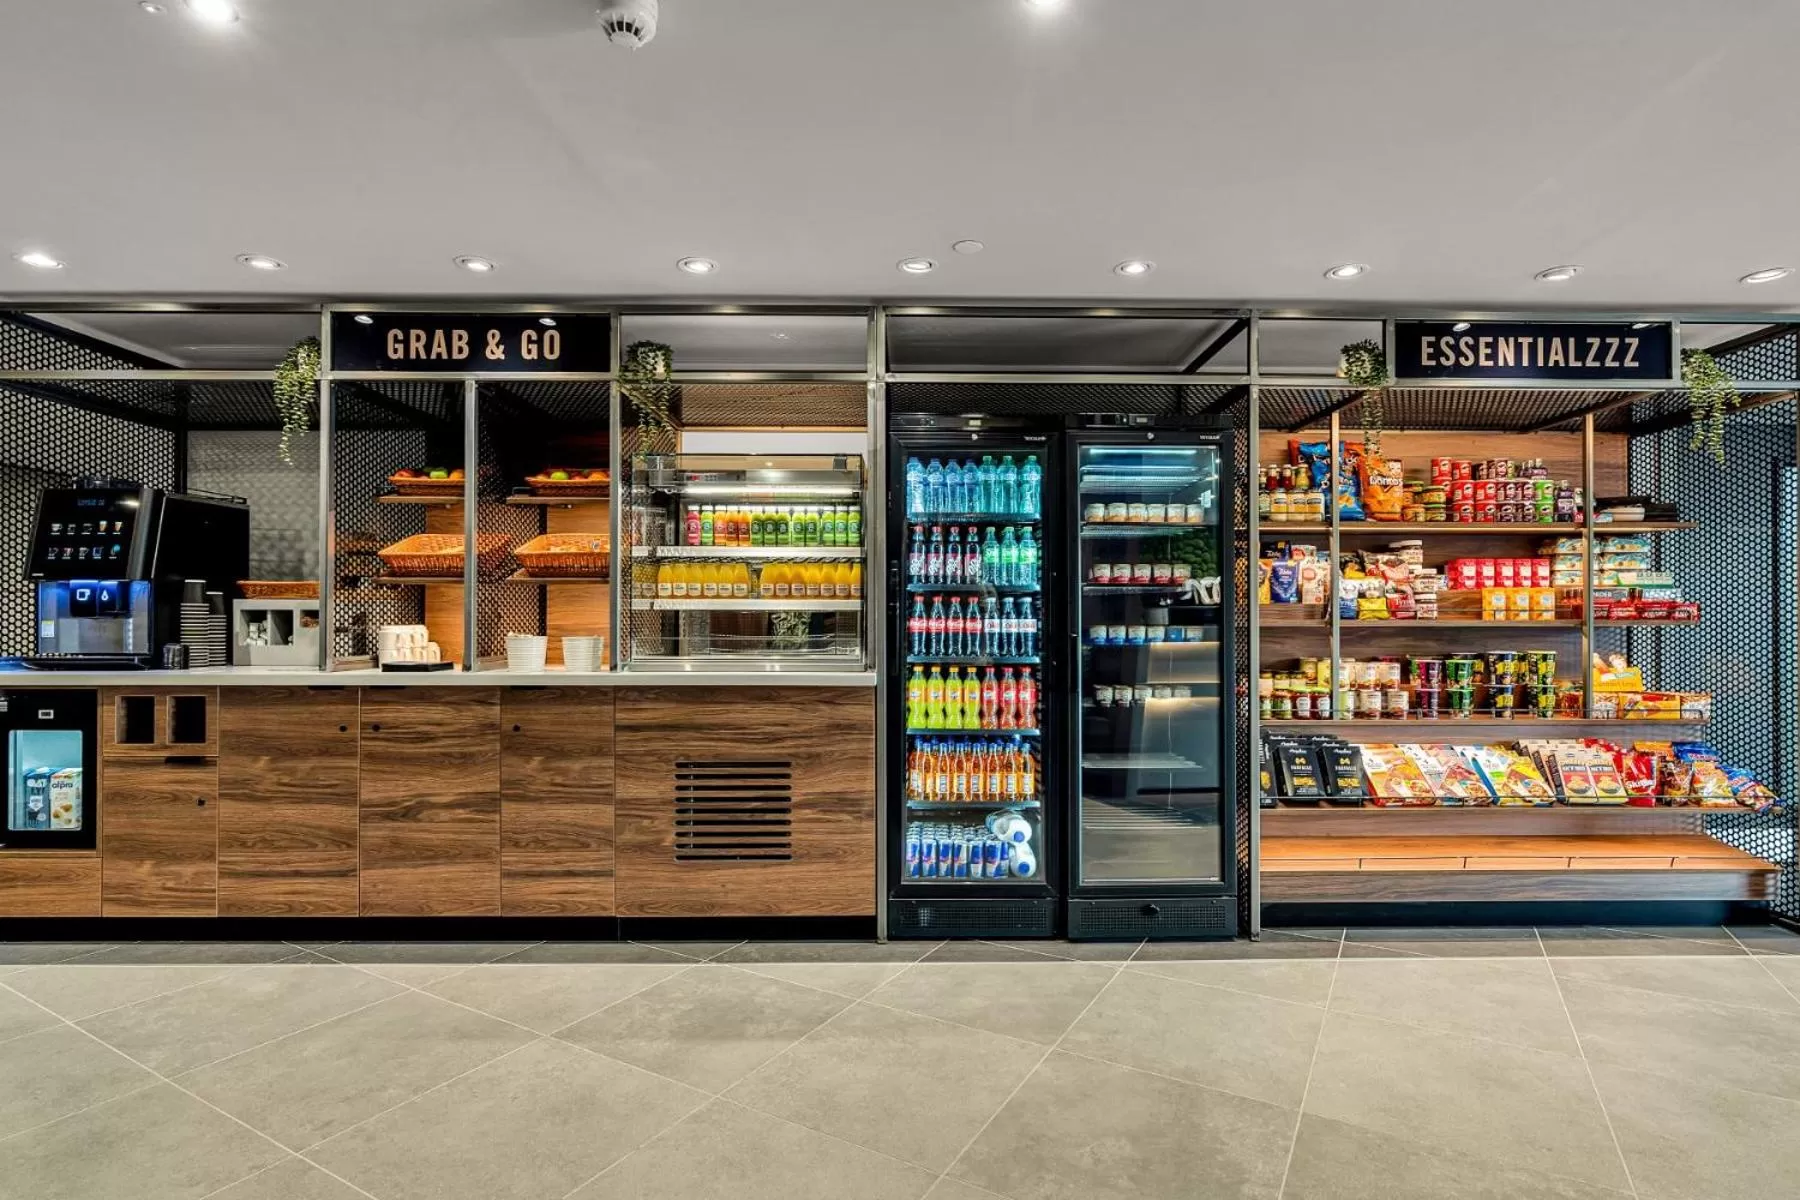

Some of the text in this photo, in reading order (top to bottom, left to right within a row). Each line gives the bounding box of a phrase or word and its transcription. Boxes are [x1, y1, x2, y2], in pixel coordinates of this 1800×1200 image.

[386, 328, 561, 361] GRAB & GO
[1420, 335, 1640, 368] ESSENTIALZZZ
